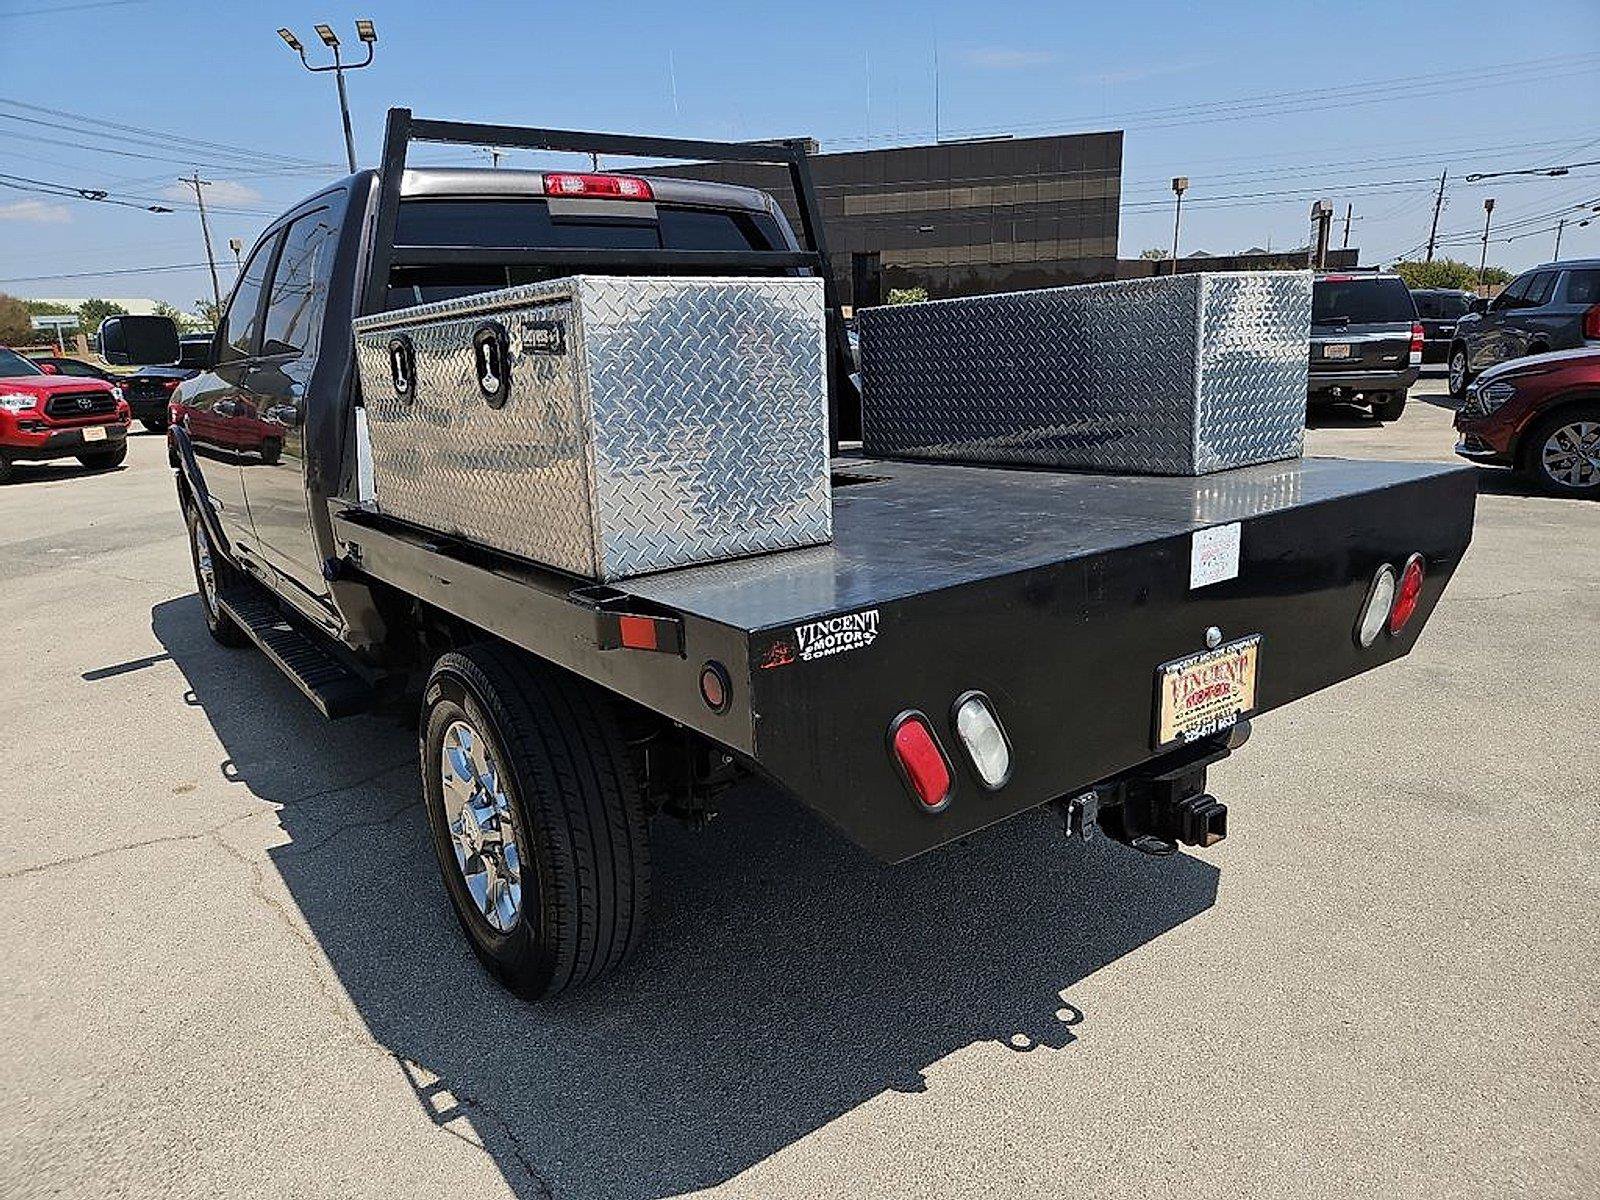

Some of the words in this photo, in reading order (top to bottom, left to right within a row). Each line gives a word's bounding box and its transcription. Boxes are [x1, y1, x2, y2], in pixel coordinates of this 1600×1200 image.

[795, 609, 880, 651] VINCENT
[814, 630, 863, 651] MOTOR
[799, 636, 877, 661] COMPANY
[1171, 655, 1248, 709] VINCENT
